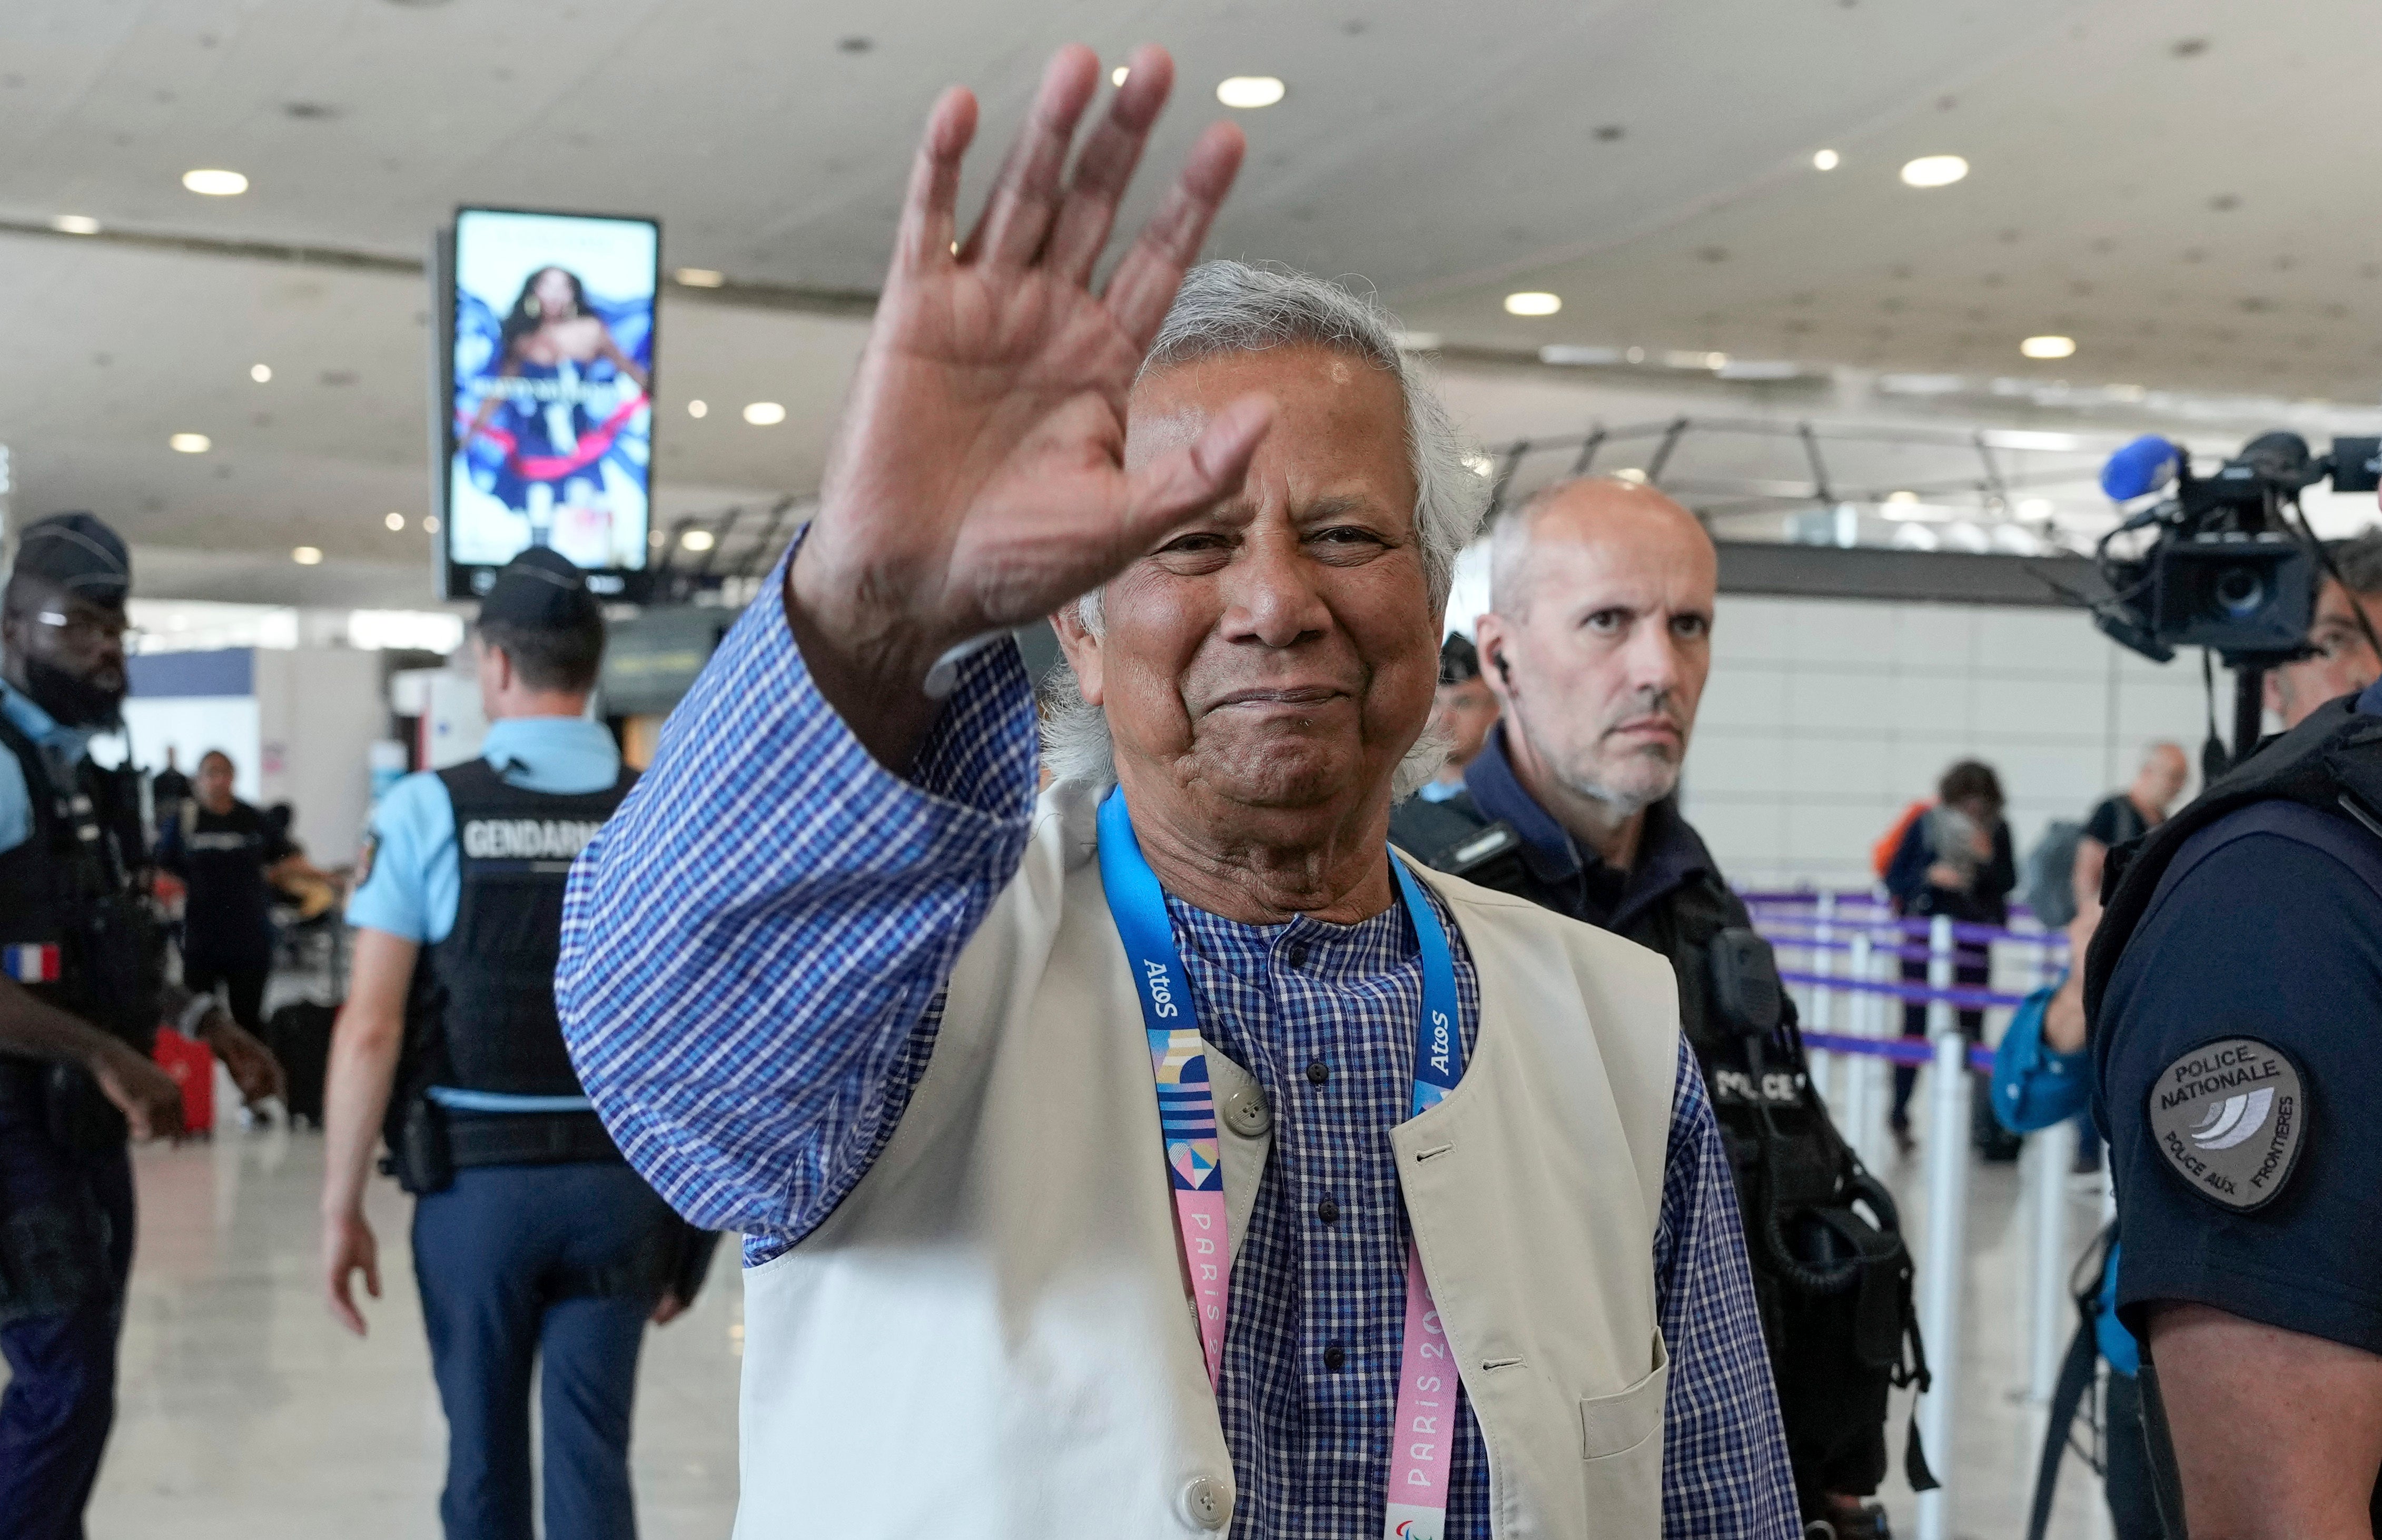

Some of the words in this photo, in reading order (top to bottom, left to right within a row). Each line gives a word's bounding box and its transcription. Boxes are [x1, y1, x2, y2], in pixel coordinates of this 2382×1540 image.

[1143, 959, 1178, 1018] Atos
[1431, 1009, 1449, 1076] Atos
[2176, 1045, 2258, 1082] POLICE
[2161, 1059, 2280, 1109] NATIONALE
[2163, 1131, 2207, 1177] POLICE
[2203, 1172, 2235, 1195] AUX
